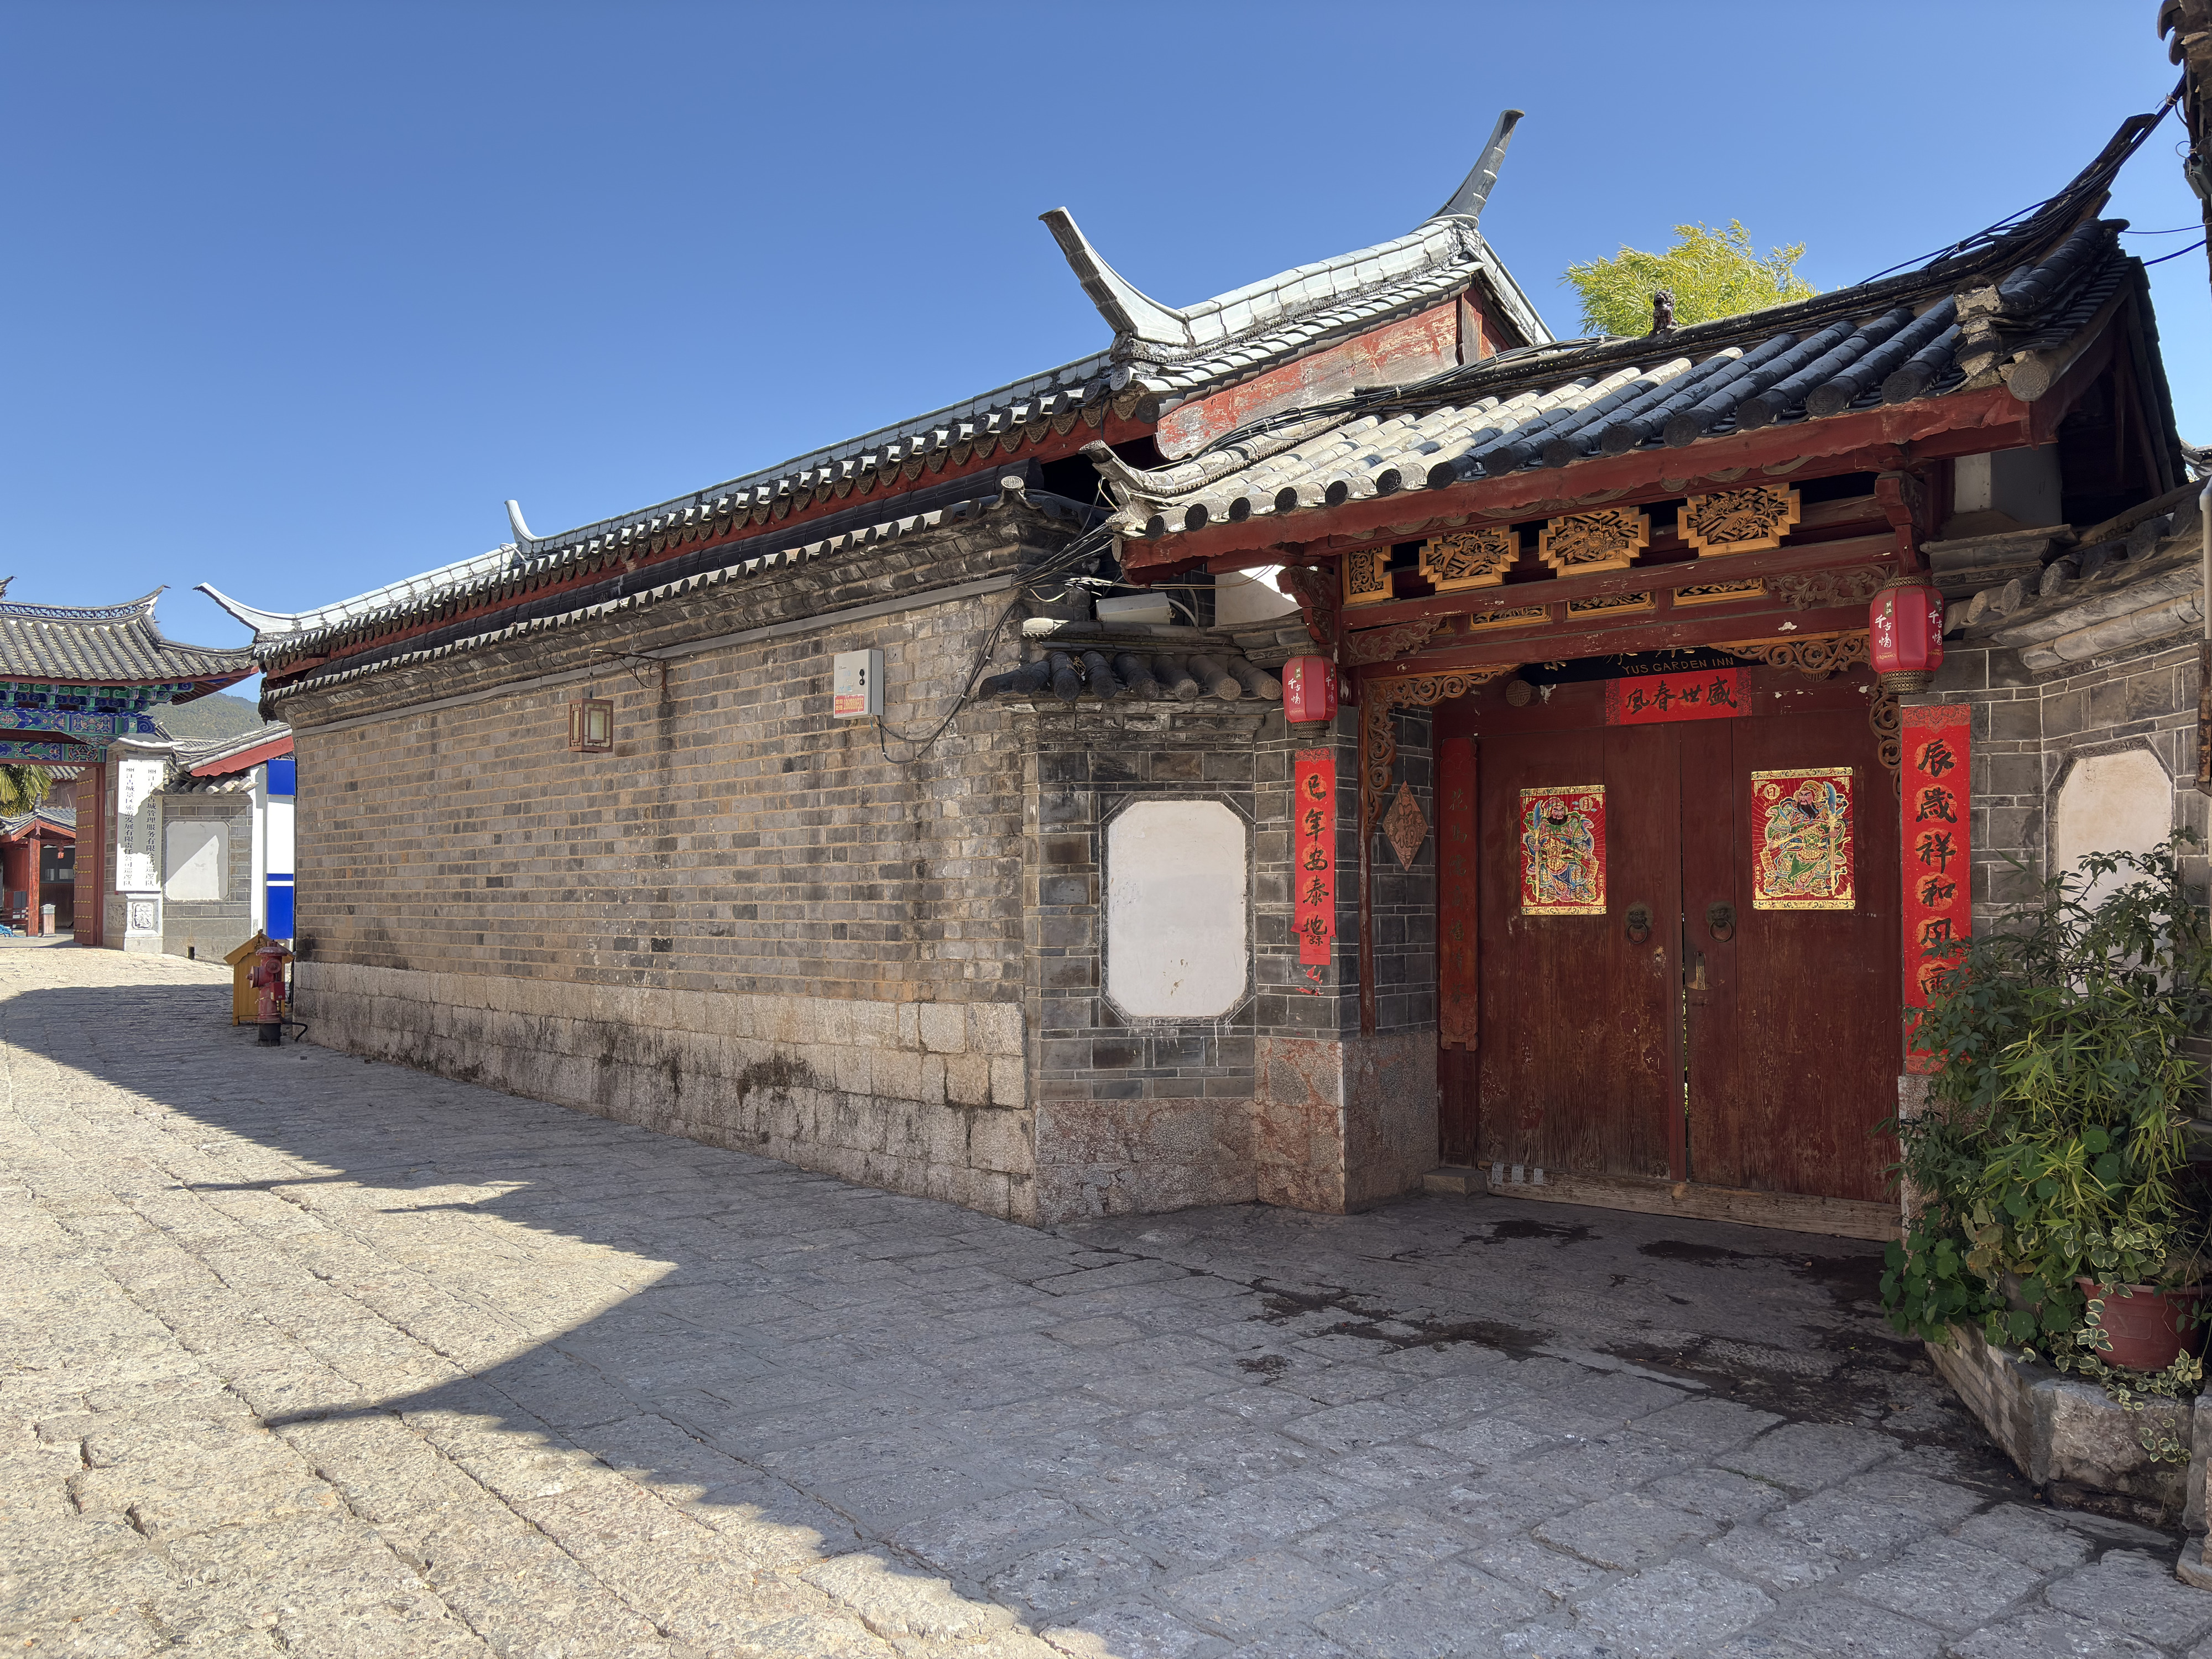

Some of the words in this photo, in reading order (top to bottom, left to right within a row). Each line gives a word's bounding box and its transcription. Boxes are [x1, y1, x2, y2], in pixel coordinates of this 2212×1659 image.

[1886, 601, 1892, 614] 丽江
[1875, 614, 1892, 648] 千古情
[1928, 610, 1943, 645] 千古情
[1296, 667, 1301, 679] 丽江
[1653, 659, 1707, 672] GARDEN
[1712, 657, 1734, 667] INN
[1287, 678, 1301, 705] 千古情
[1326, 676, 1334, 703] 千古情
